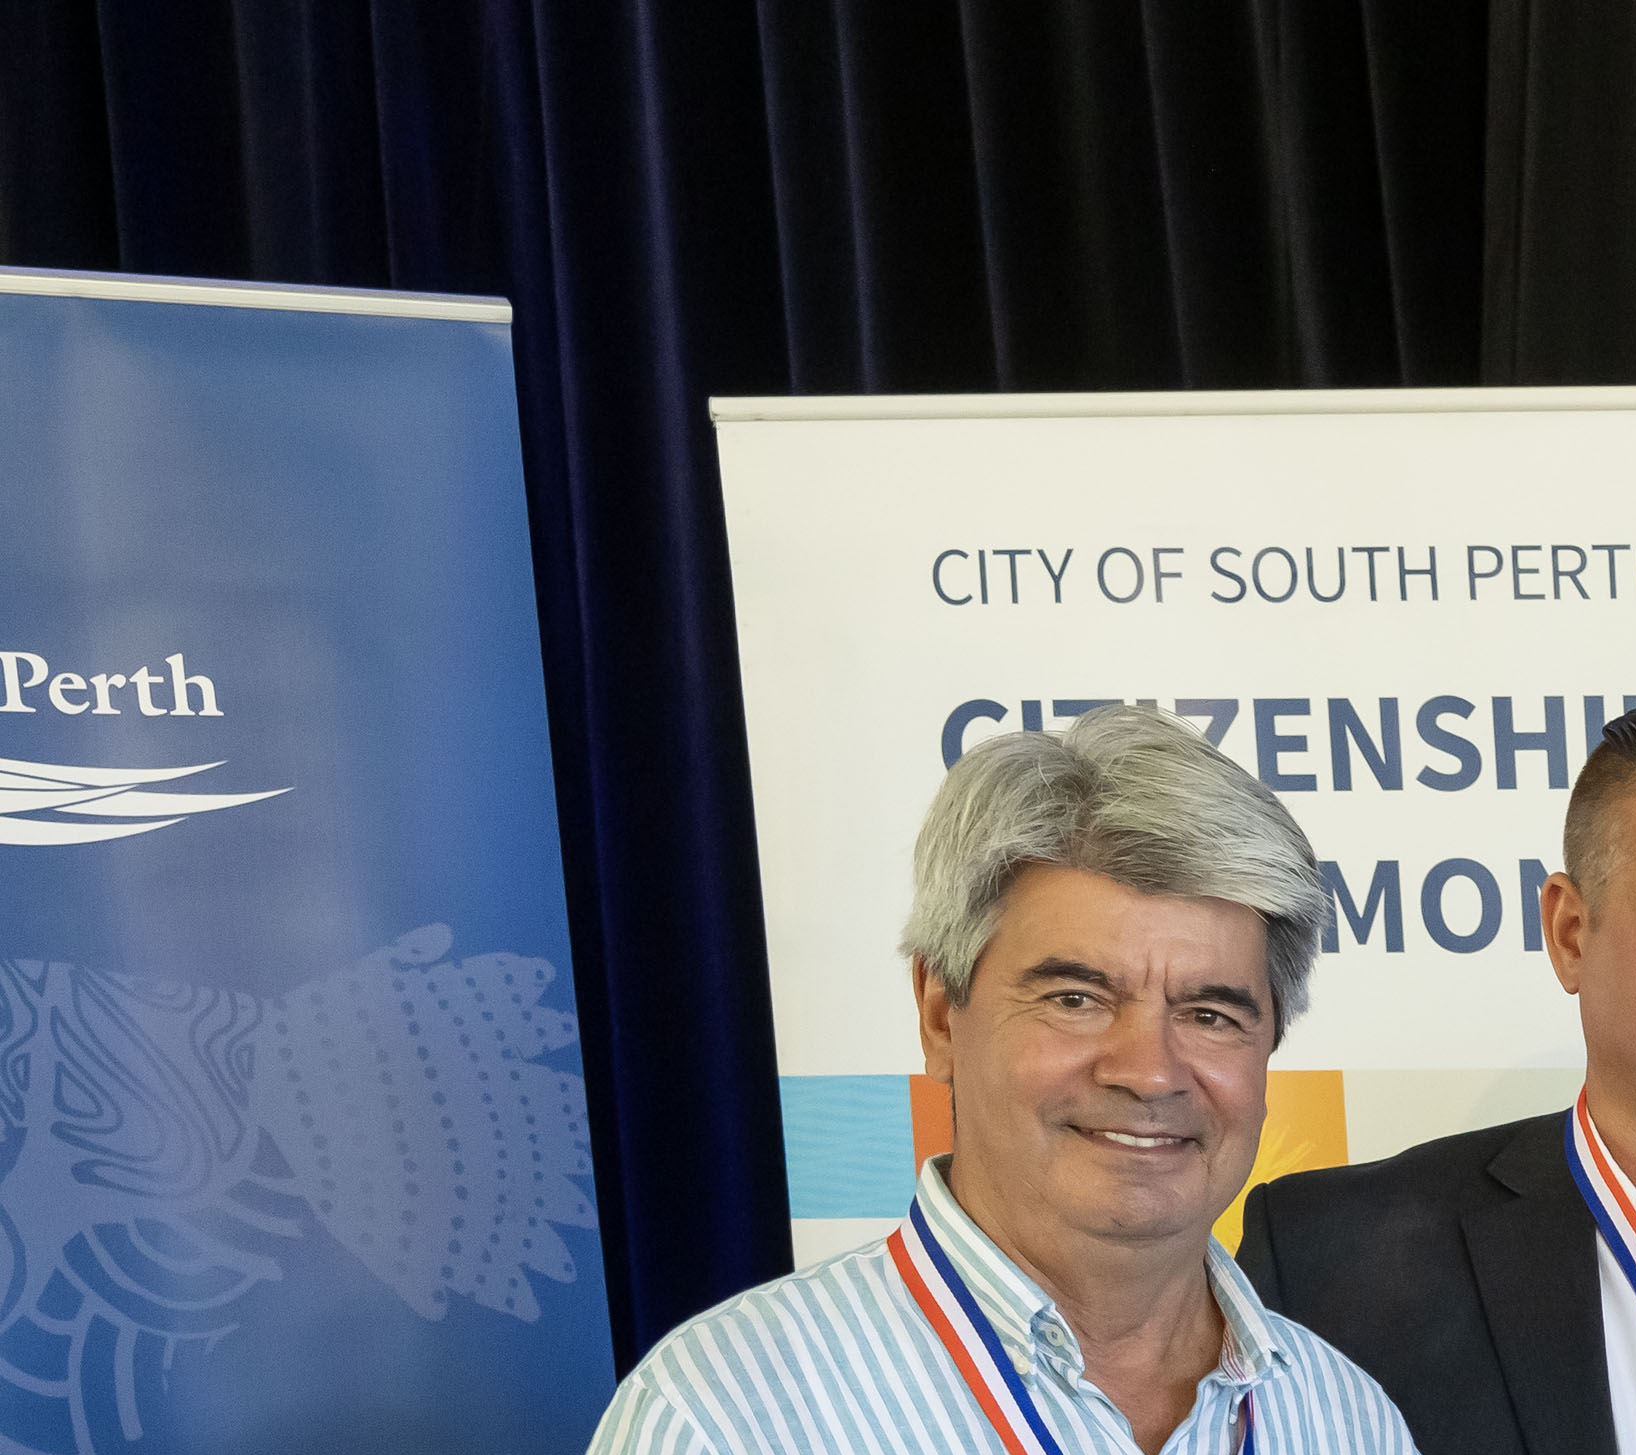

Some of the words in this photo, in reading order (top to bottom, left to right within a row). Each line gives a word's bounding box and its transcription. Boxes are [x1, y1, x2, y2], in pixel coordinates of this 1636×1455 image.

[931, 546, 1074, 607] CITY
[1096, 546, 1185, 605] OF
[1211, 545, 1437, 603] SOUTH
[0, 652, 225, 717] Perth
